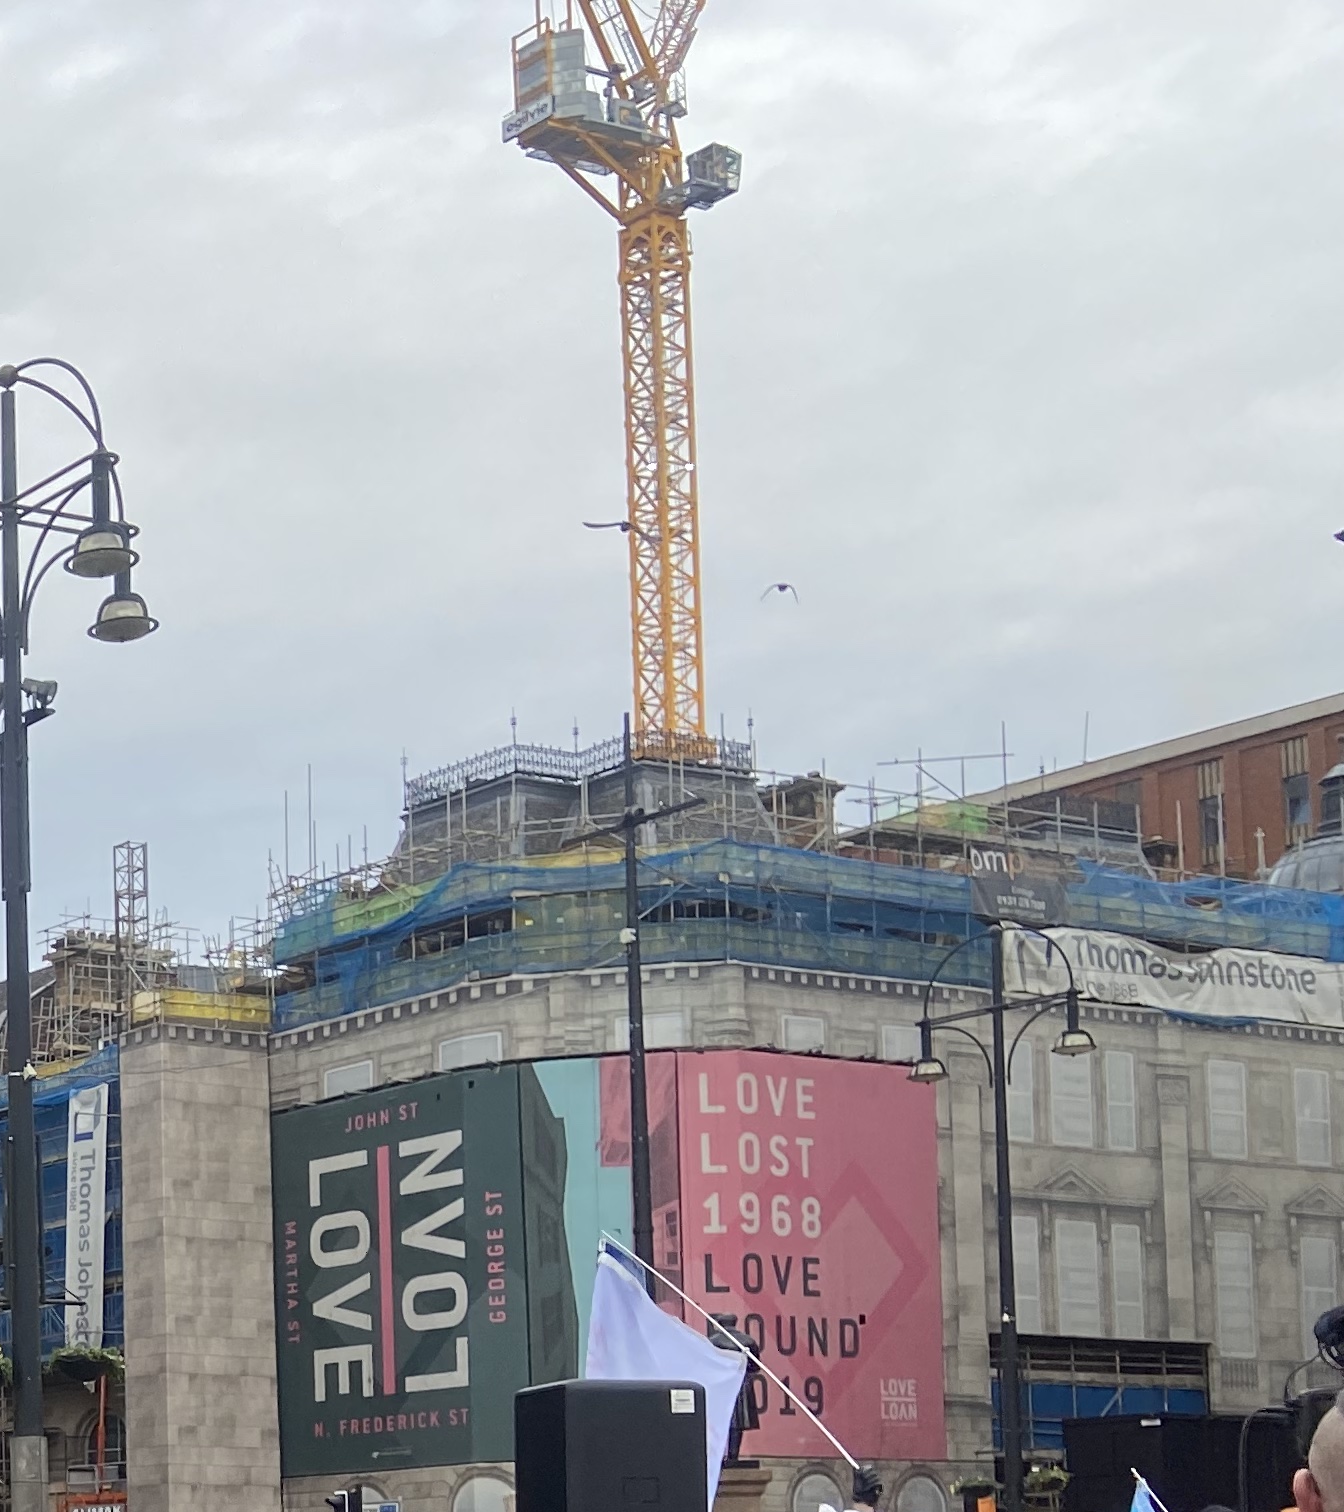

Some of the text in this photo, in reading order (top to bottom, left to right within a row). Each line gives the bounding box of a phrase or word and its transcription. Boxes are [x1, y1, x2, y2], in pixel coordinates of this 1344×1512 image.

[344, 1102, 419, 1133] JOHN ST
[698, 1072, 817, 1120] LOVE
[701, 1131, 815, 1178] LOST
[77, 1147, 96, 1252] Thomas
[702, 1192, 822, 1240] 1968
[308, 1149, 374, 1403] LOVE
[485, 1191, 507, 1324] GEORGE ST
[704, 1252, 822, 1297] LOVE
[284, 1220, 301, 1345] MARTHA ST
[752, 1374, 824, 1418] 019
[880, 1378, 917, 1396] LOVE
[339, 1410, 440, 1436] FREDERICK
[449, 1408, 470, 1425] ST
